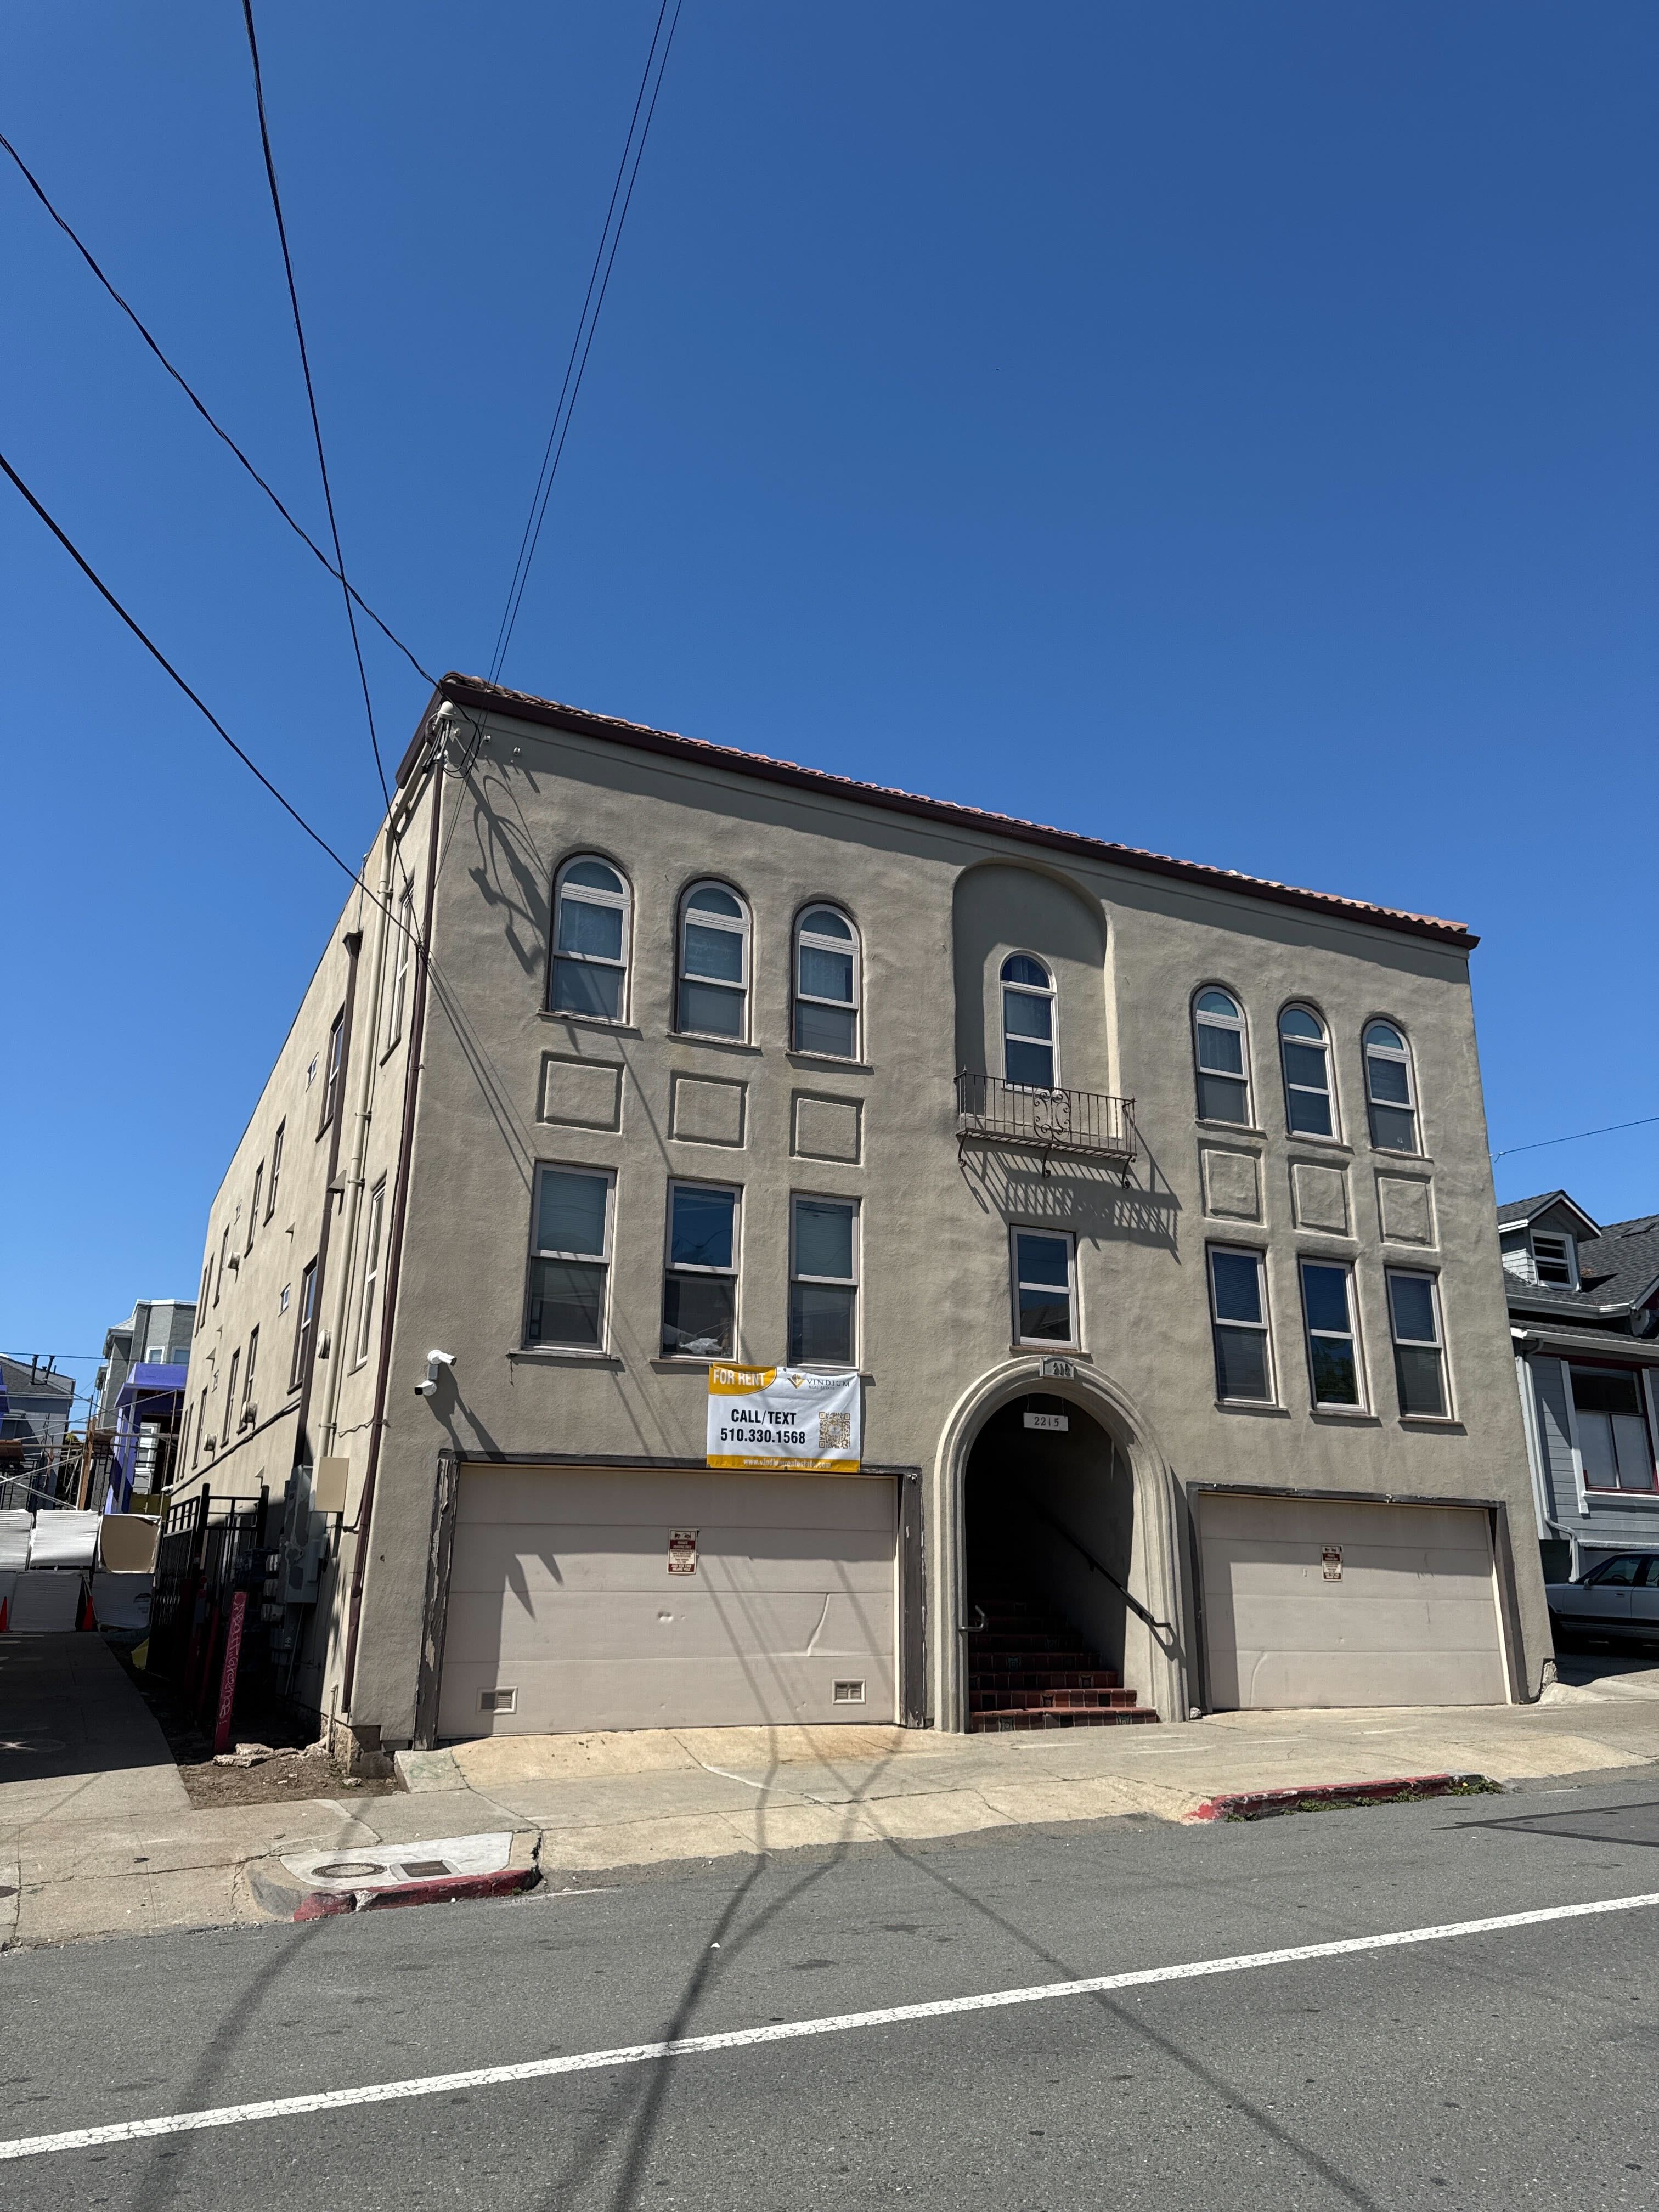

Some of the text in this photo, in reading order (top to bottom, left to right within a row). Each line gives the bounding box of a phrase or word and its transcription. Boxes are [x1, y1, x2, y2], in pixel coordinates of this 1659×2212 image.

[713, 1369, 766, 1387] FOR RENT
[807, 1379, 849, 1387] VINDIUM
[731, 1409, 797, 1425] CALL/TEXT
[1034, 1416, 1059, 1427] 2215
[720, 1427, 806, 1444] 510.330.1568
[743, 1458, 831, 1469] www.vindiumrealestate.com
